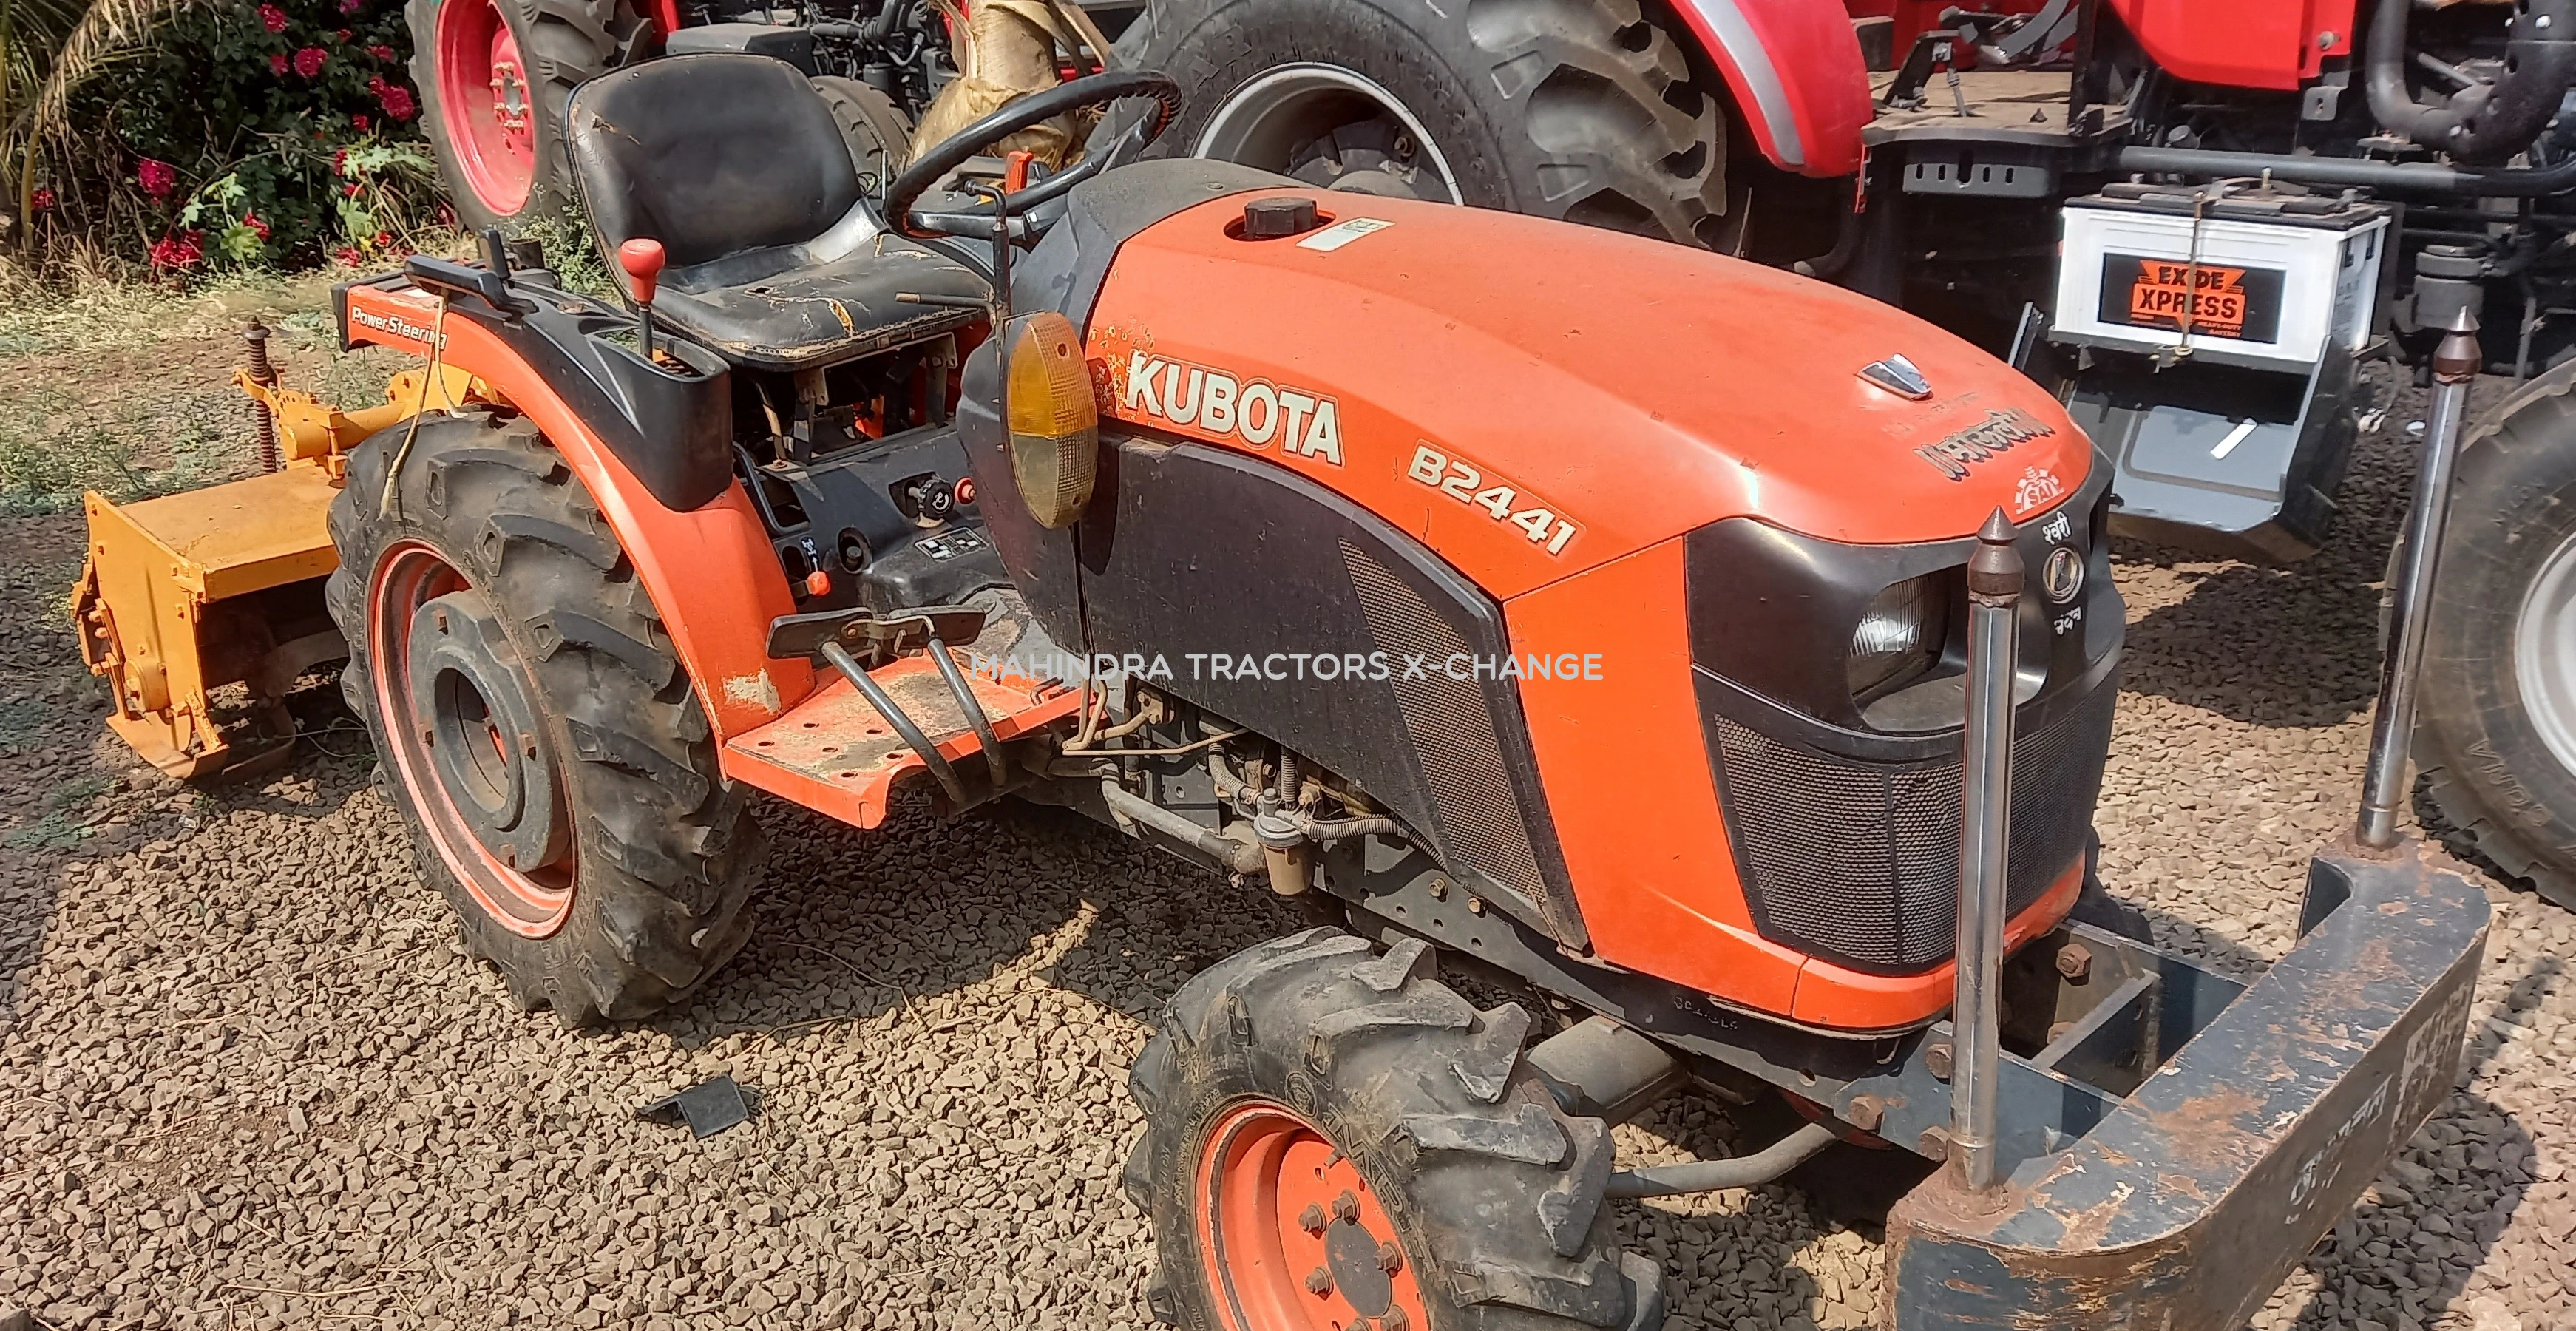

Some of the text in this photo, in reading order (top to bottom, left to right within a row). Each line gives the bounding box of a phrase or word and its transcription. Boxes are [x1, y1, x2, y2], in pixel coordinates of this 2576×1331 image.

[2158, 265, 2226, 290] EXDE
[1125, 350, 1343, 465] KUBOTA
[1407, 445, 1577, 556] B2441
[2027, 483, 2055, 505] SAI
